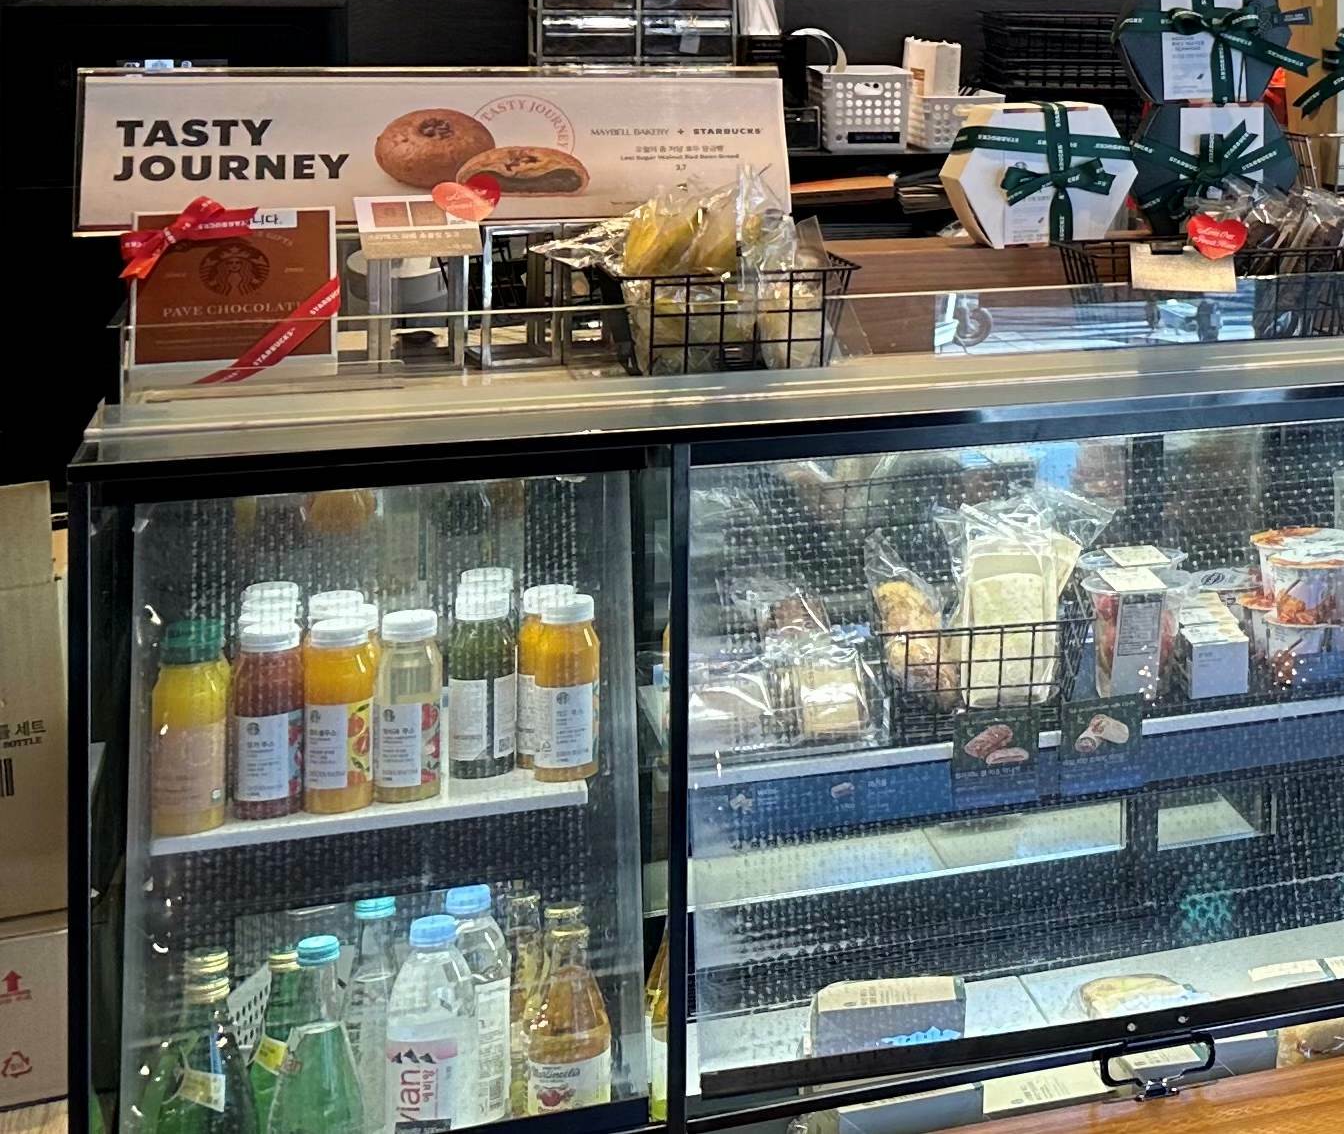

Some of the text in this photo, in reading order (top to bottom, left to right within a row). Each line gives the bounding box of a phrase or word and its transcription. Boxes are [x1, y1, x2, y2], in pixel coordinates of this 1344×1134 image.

[116, 119, 273, 147] TASTY
[481, 99, 569, 149] TASTY JOURNEY
[590, 128, 632, 136] MAYBELL
[634, 128, 670, 136] BAKERY
[693, 127, 762, 136] STARBUCKS
[113, 154, 350, 182] JOURNEY
[163, 306, 203, 318] PAVE
[252, 327, 296, 366] STARBUCKS
[15, 719, 46, 736] 세트
[3, 736, 42, 749] BOTTLE
[423, 1069, 435, 1103] 에비앙
